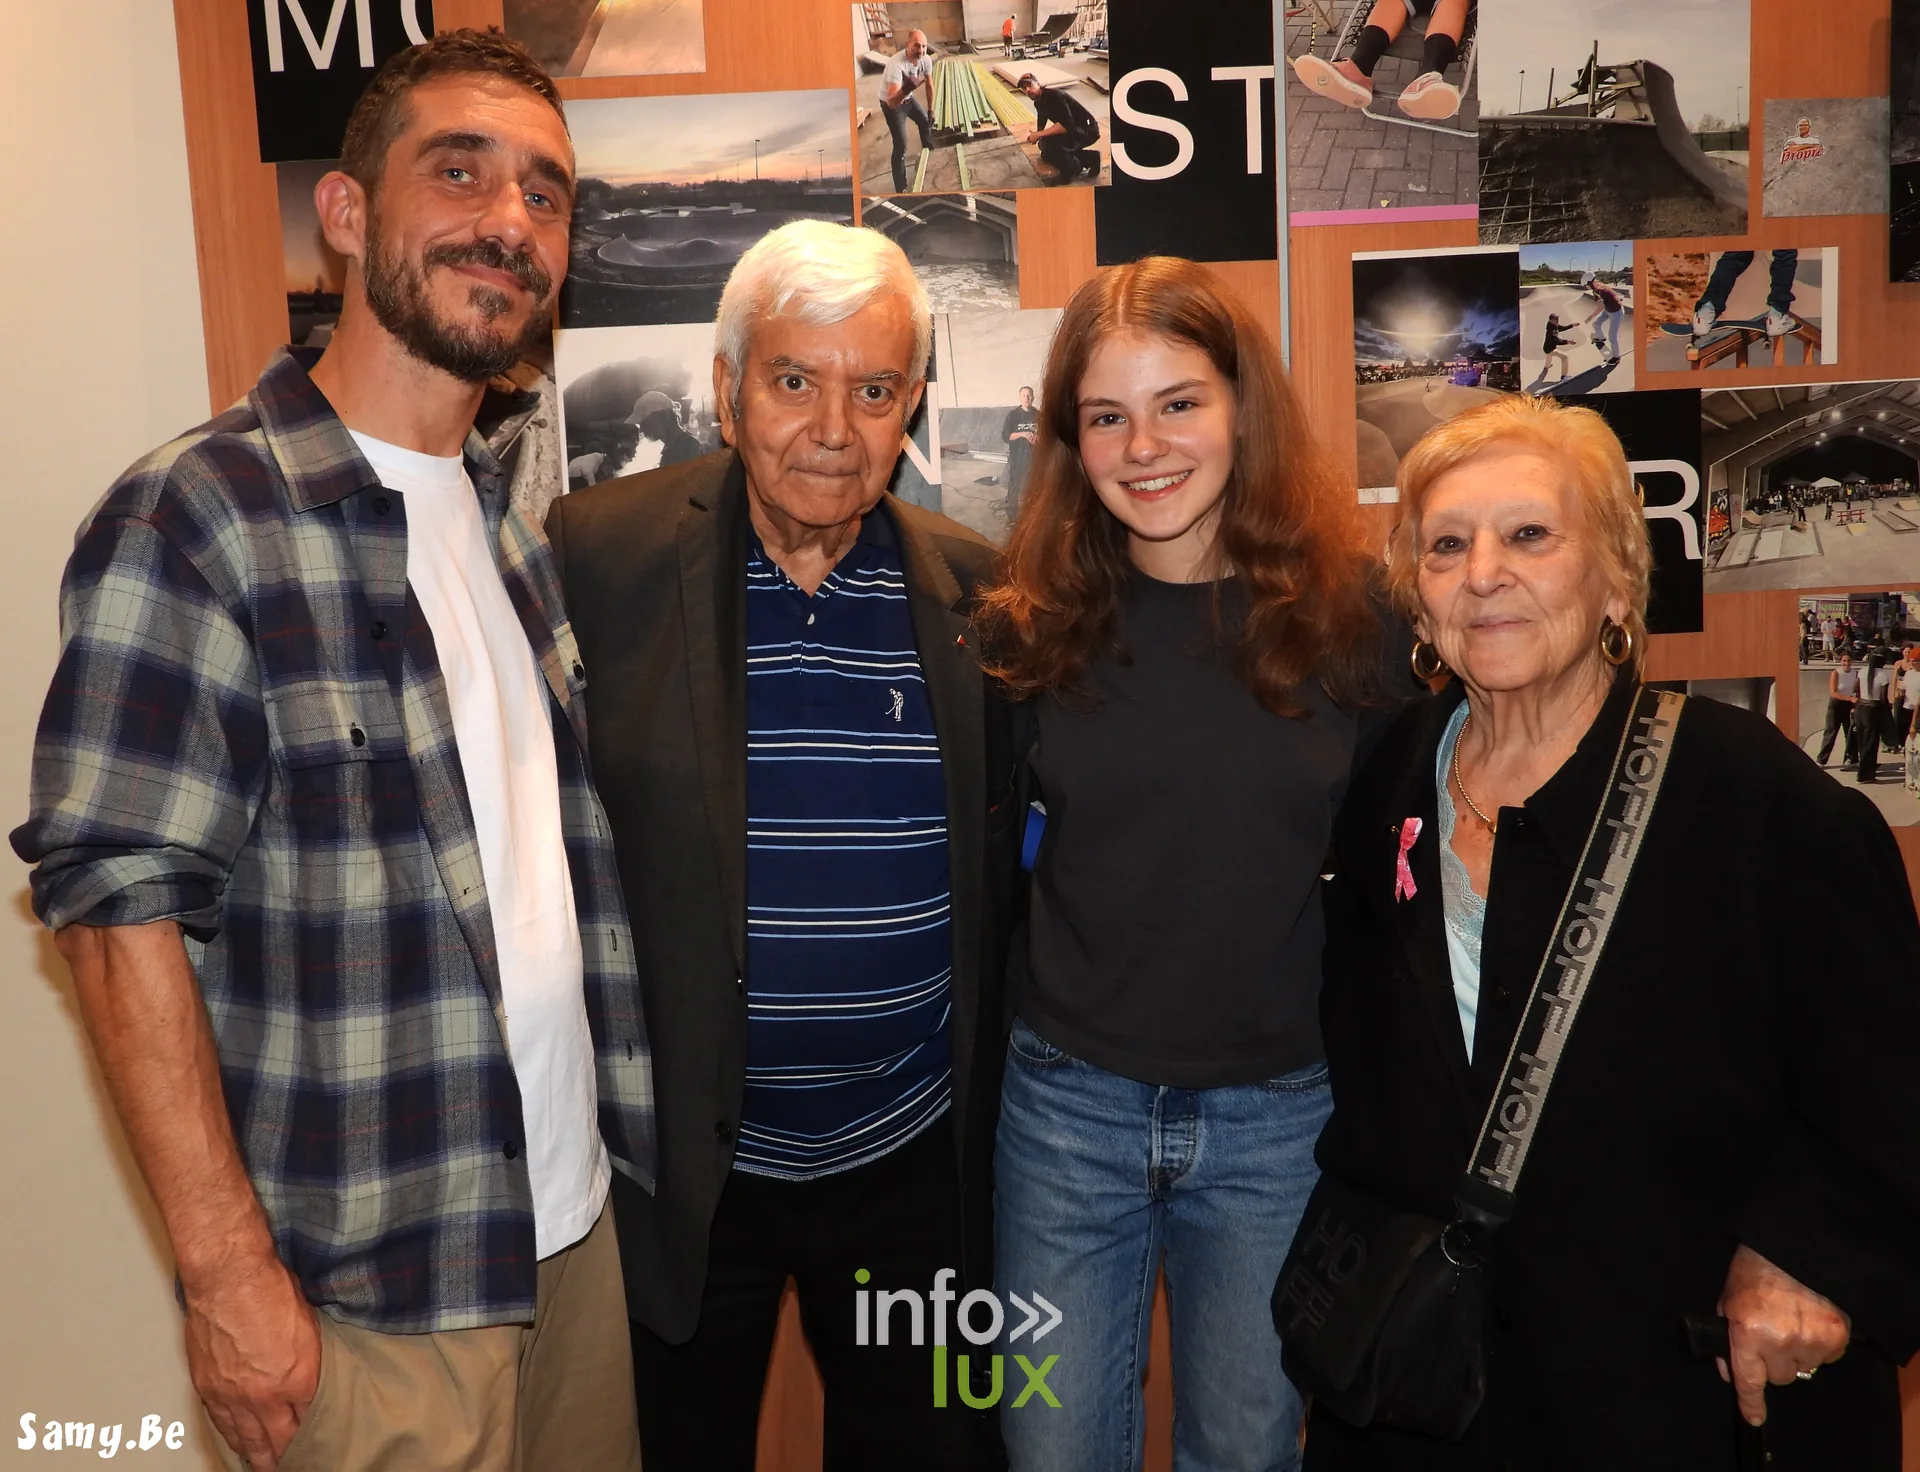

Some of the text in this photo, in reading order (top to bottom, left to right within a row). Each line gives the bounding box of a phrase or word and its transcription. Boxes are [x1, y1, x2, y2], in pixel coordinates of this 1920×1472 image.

[264, 0, 428, 72] M
[1111, 65, 1275, 180] ST
[1605, 716, 1670, 859] HOFF
[1541, 877, 1616, 1034] HOFF
